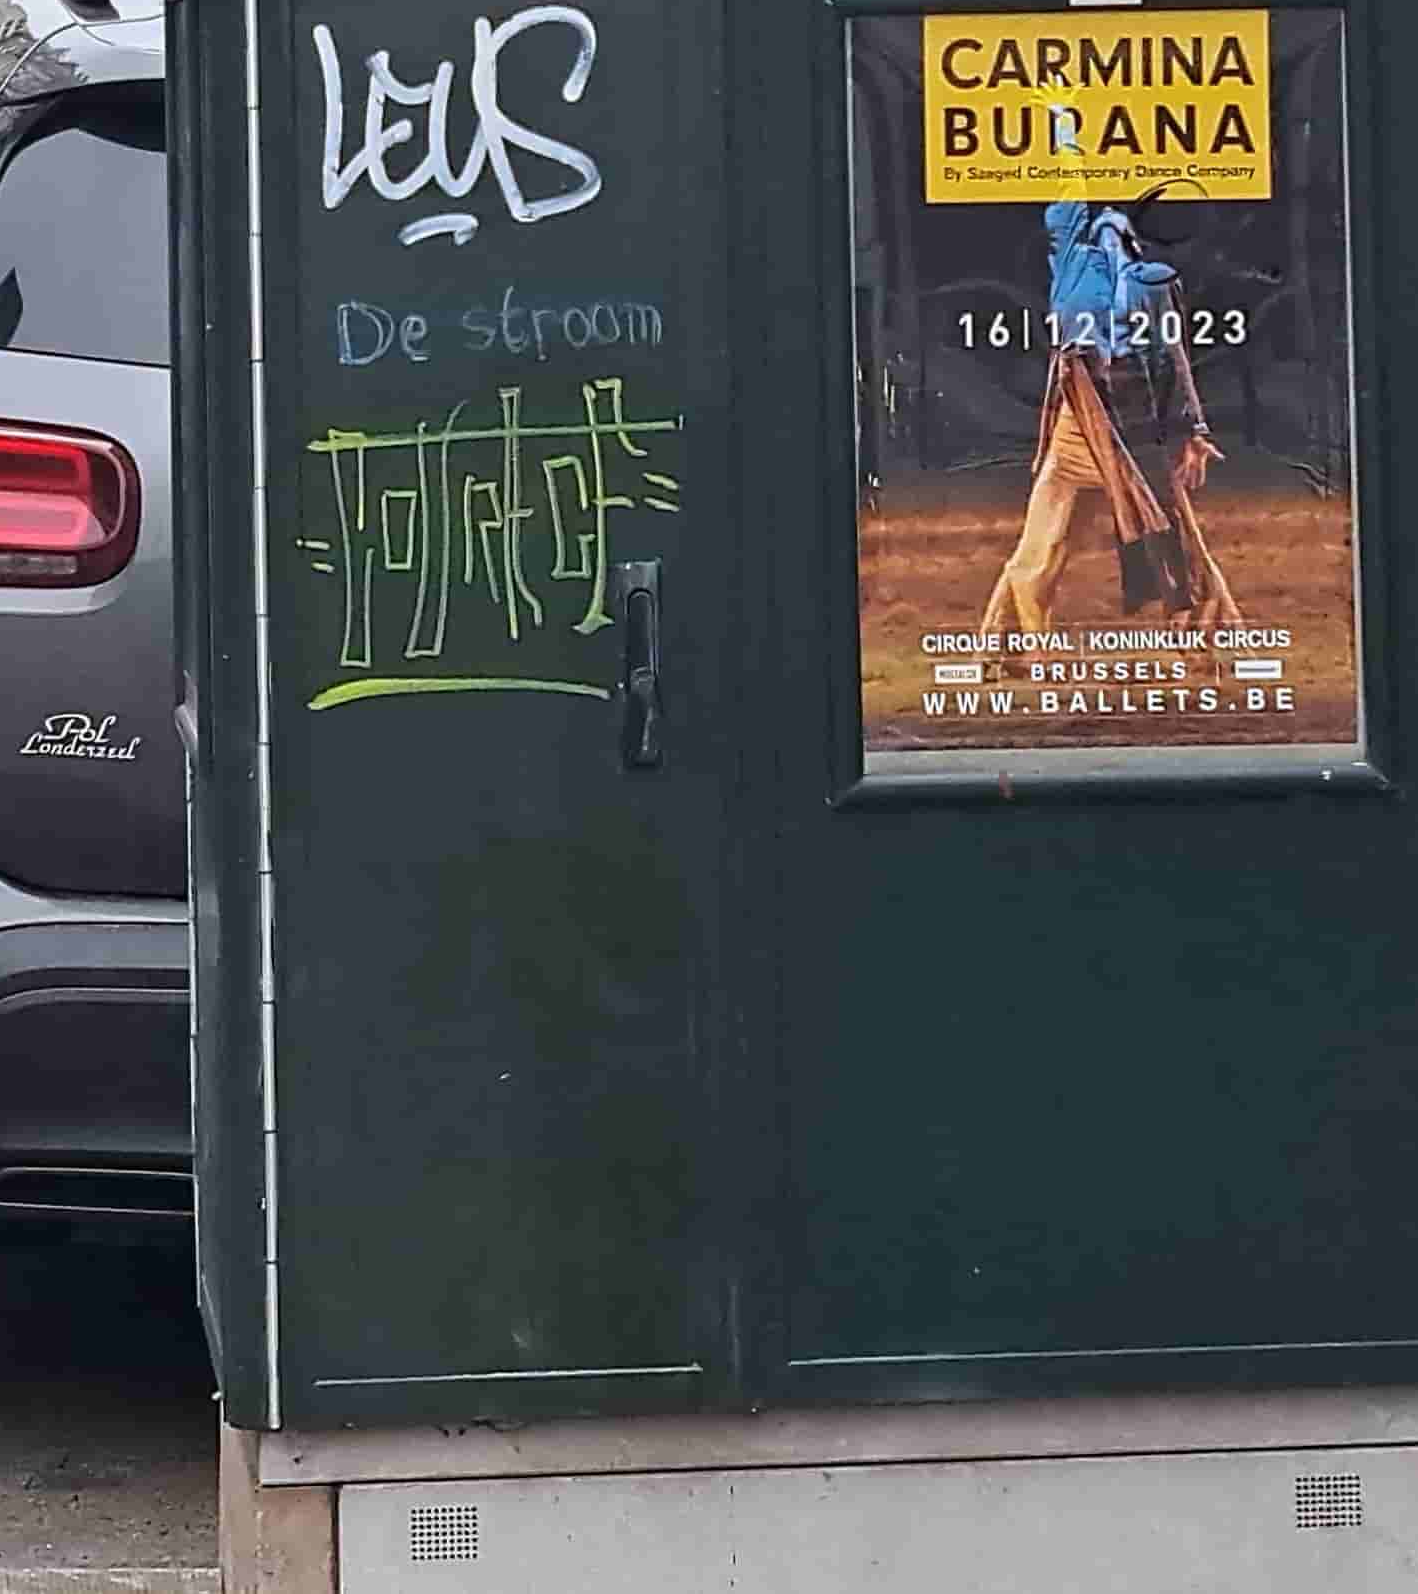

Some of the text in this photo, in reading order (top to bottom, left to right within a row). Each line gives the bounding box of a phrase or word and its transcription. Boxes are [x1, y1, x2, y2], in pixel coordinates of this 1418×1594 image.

[940, 36, 1255, 89] CARMINA
[944, 104, 1256, 157] BURANA
[944, 166, 961, 182] By
[1027, 164, 1130, 181] Contemporary
[1135, 163, 1182, 178] Dance
[1187, 162, 1256, 180] Company
[337, 286, 664, 365] De stroom
[922, 634, 1000, 654] CIRQUE
[1008, 631, 1075, 652] ROYAL
[1214, 629, 1291, 649] CIRCUS
[1030, 661, 1188, 681] BRUSSELS
[923, 687, 1294, 716] WWW.BALLETS.BE
[44, 713, 117, 743] Pol
